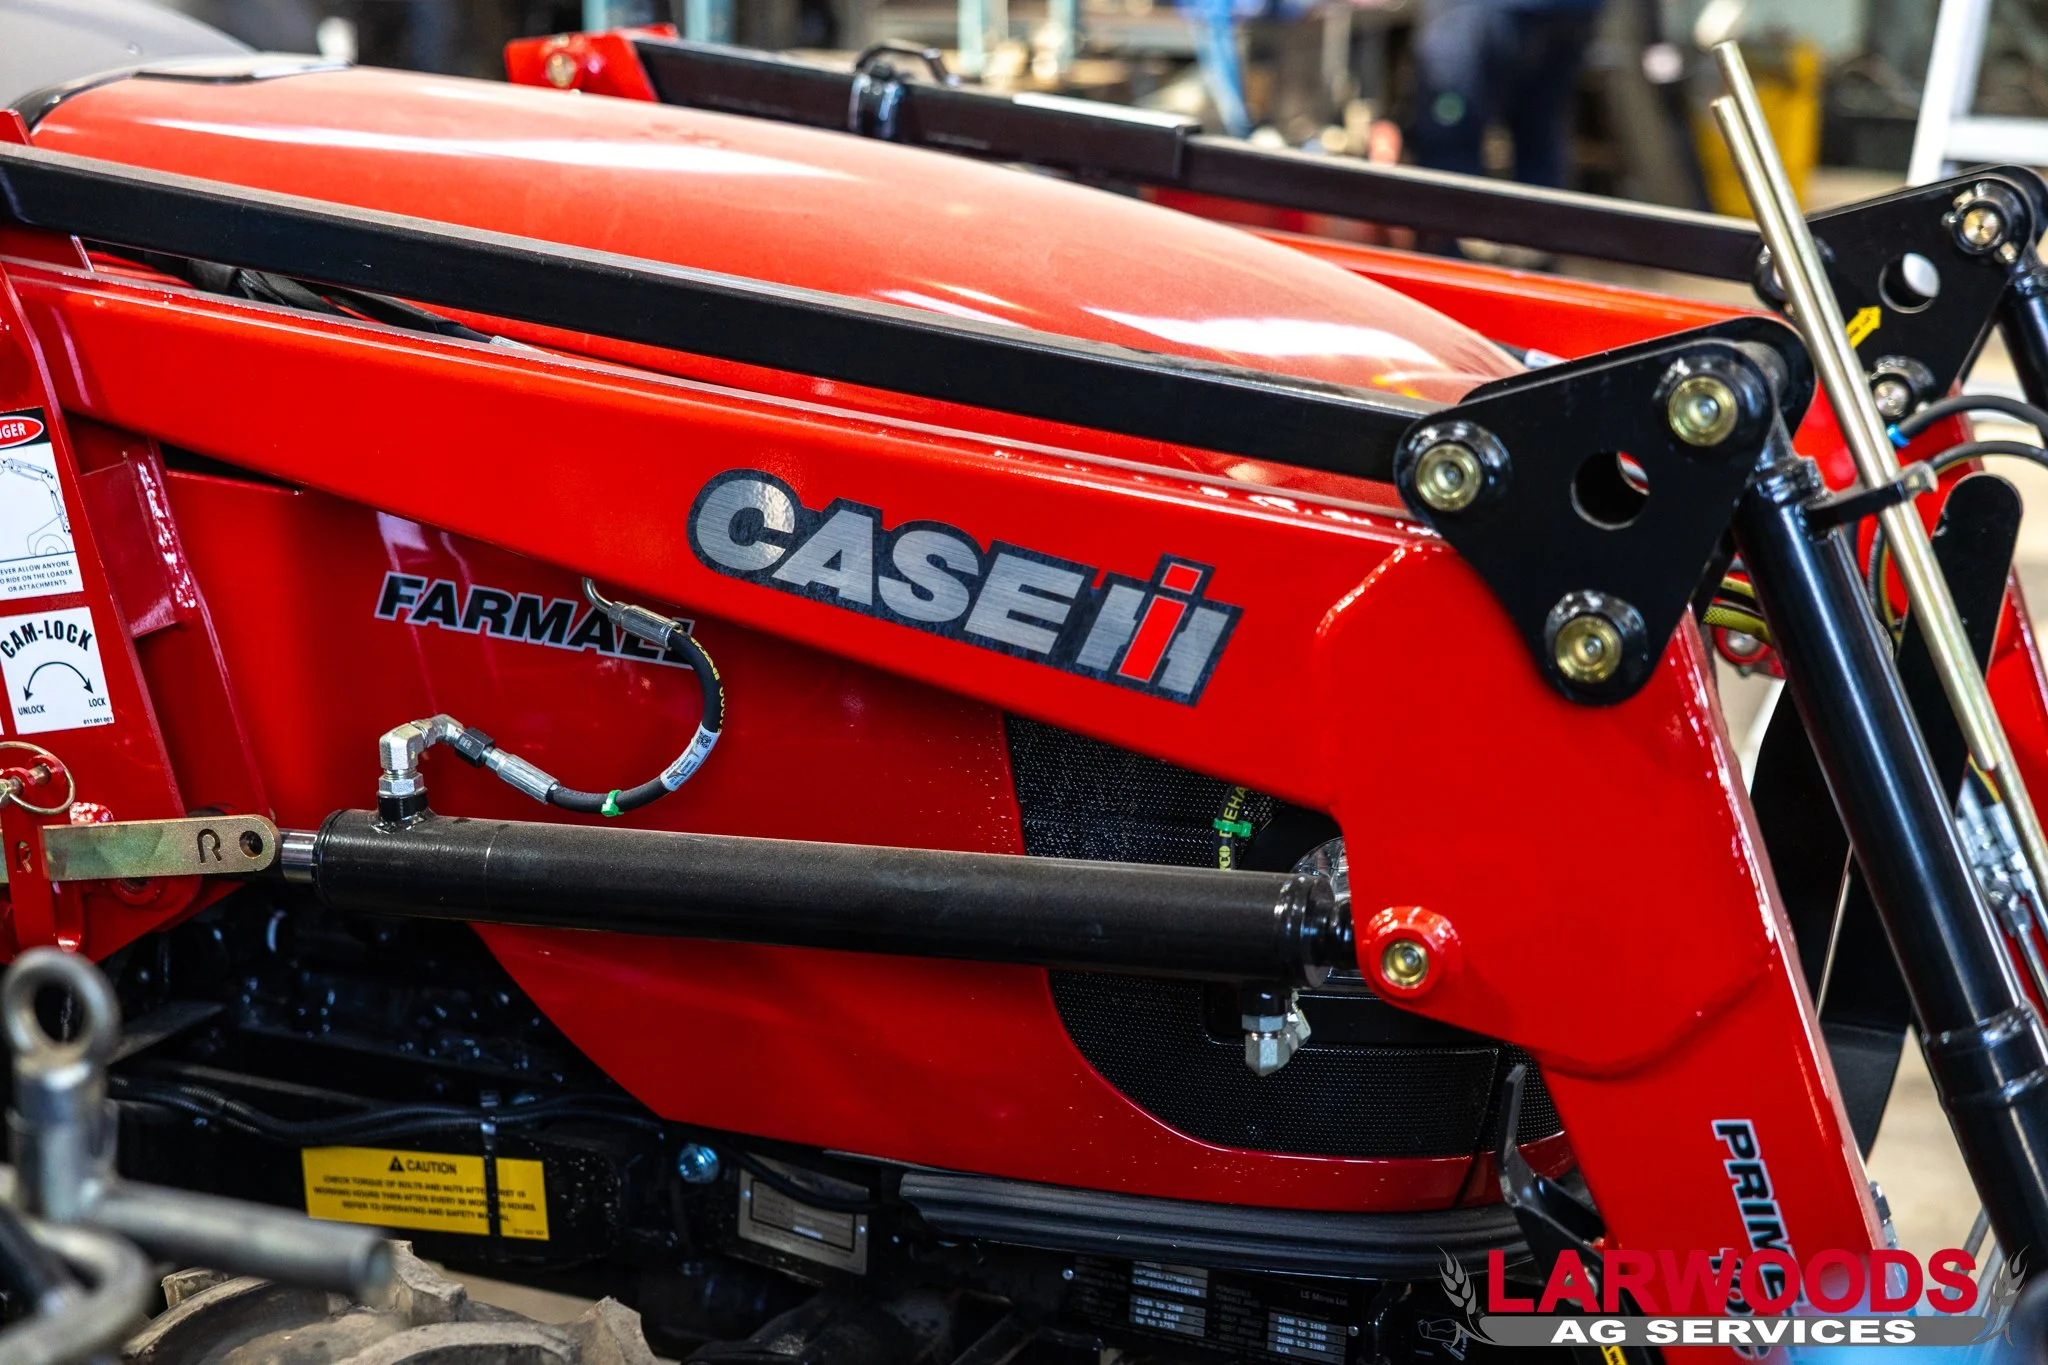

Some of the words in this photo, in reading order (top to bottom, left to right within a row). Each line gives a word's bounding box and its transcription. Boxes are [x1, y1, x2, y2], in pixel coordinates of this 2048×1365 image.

[18, 564, 41, 573] ALLOW
[42, 560, 71, 570] ANYONE
[691, 474, 1088, 658] CASE
[6, 576, 20, 584] RIDE
[21, 574, 33, 582] ON
[33, 572, 46, 580] THE
[47, 569, 74, 579] LOADER
[8, 585, 18, 593] OR
[18, 579, 68, 592] ATTACHMENTS
[0, 619, 94, 659] CAM-LOCK
[88, 697, 107, 708] LOCK
[17, 704, 46, 716] UNLOCK
[407, 1158, 457, 1175] CAUTION
